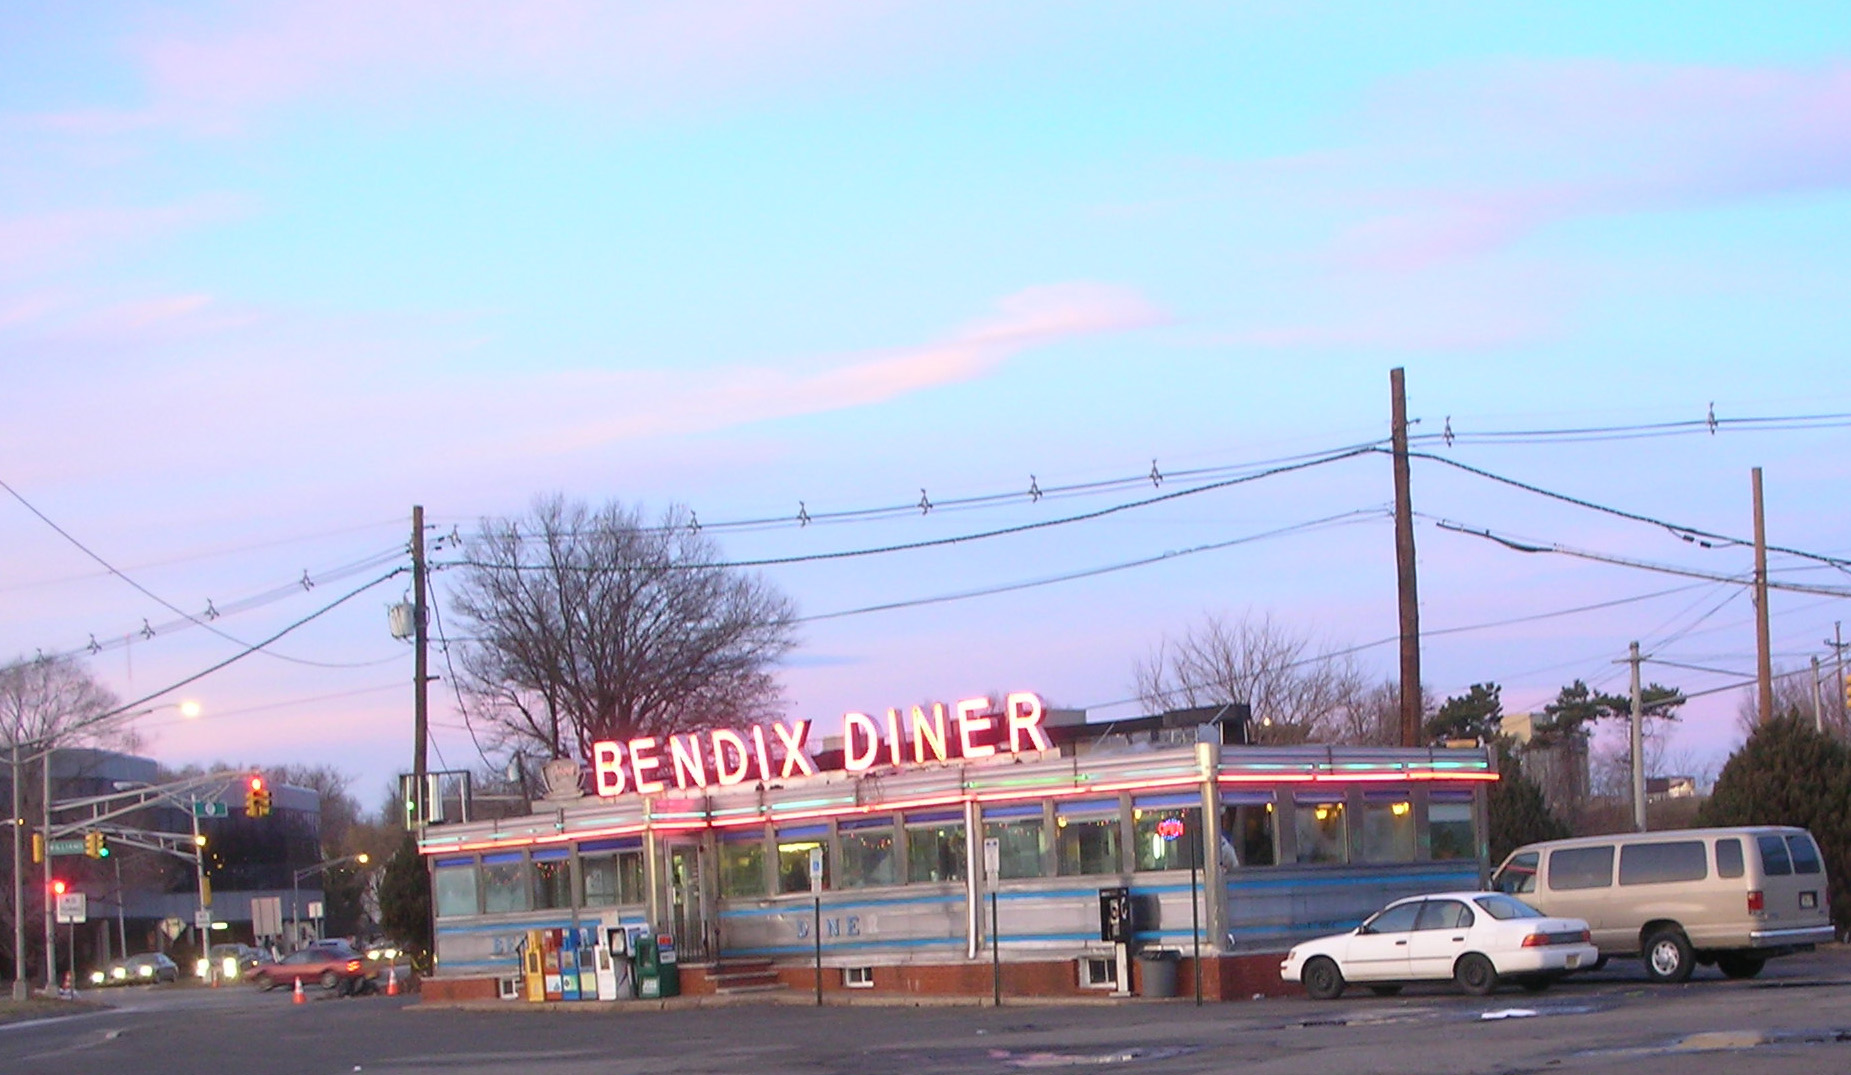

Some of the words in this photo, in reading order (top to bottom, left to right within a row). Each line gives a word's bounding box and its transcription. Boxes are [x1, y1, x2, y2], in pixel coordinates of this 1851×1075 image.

[593, 718, 817, 797] BENDIX
[843, 691, 1051, 771] DINER
[1157, 821, 1184, 837] OPEN
